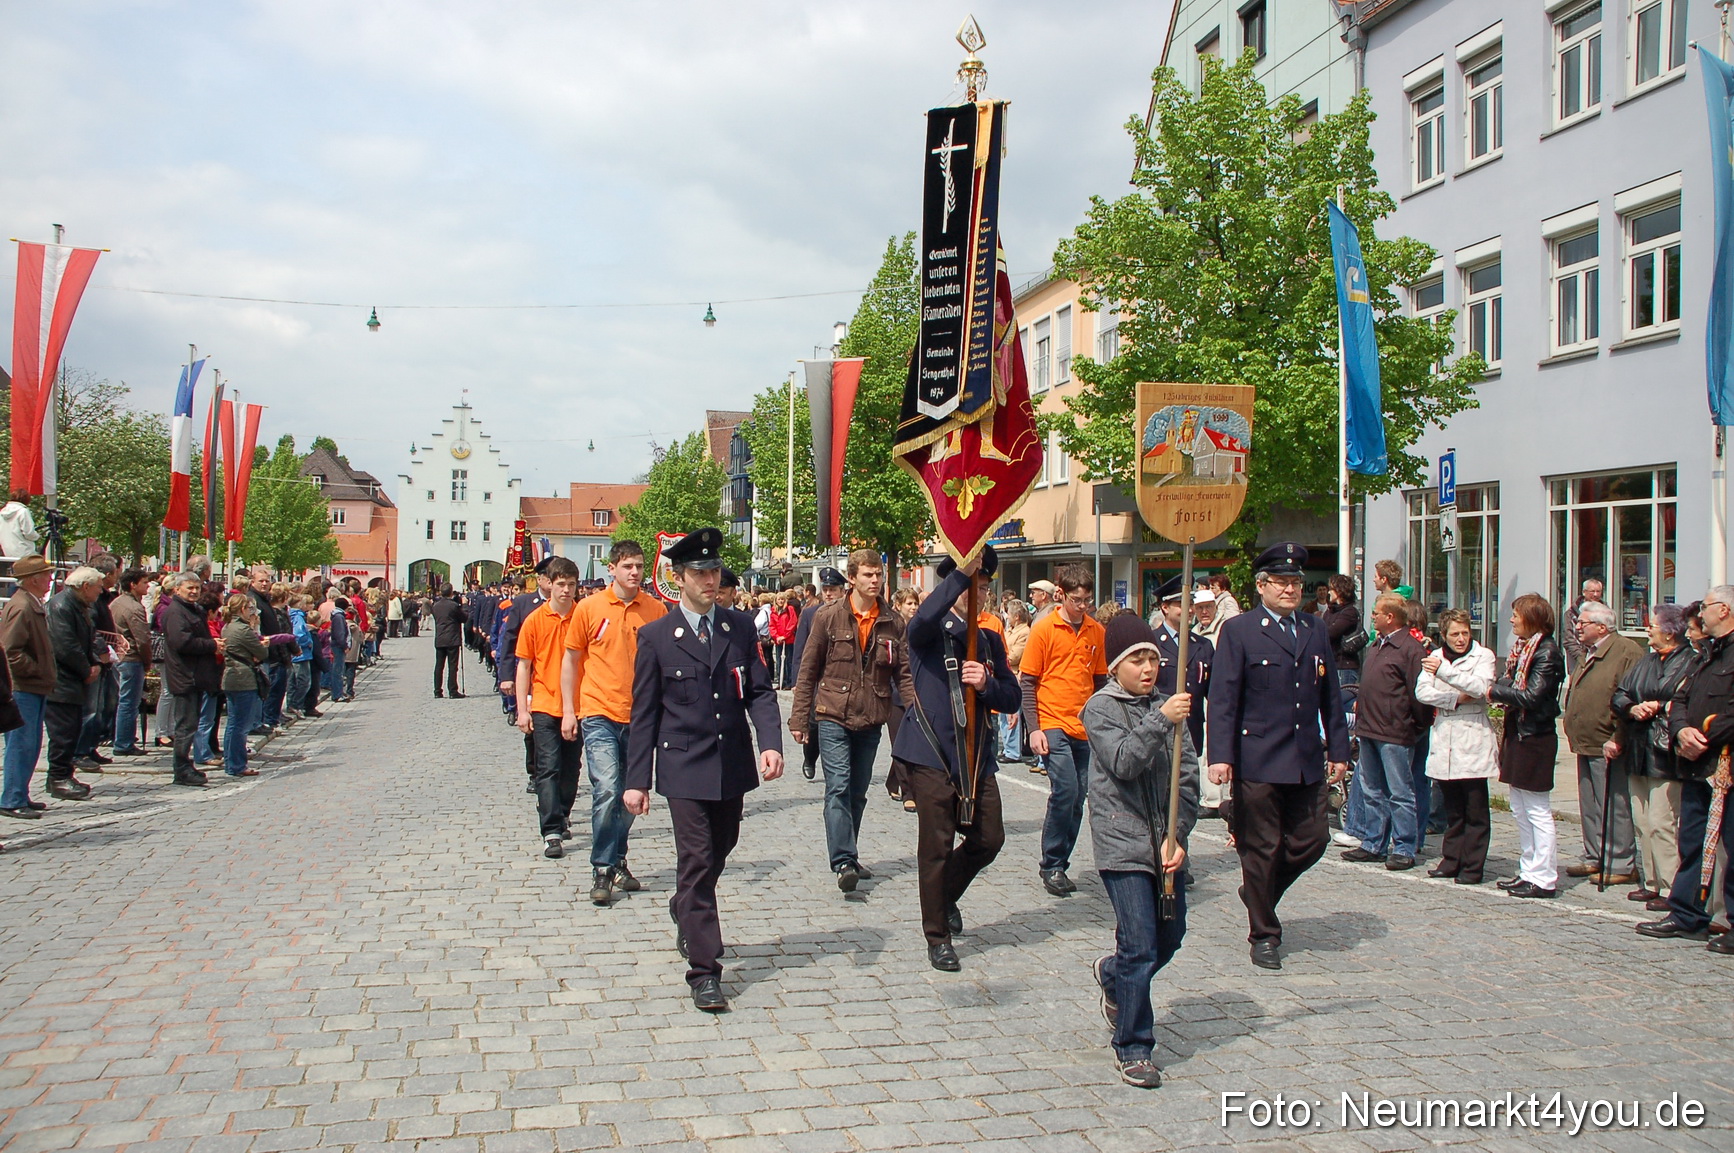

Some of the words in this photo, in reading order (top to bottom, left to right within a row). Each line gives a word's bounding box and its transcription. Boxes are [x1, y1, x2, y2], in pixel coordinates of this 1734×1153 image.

[923, 303, 962, 322] Kameraden
[926, 346, 954, 358] Gemeinde
[930, 387, 944, 399] 1974
[1441, 460, 1451, 499] P
[1174, 508, 1212, 526] Forst
[332, 568, 369, 576] Sparkasse
